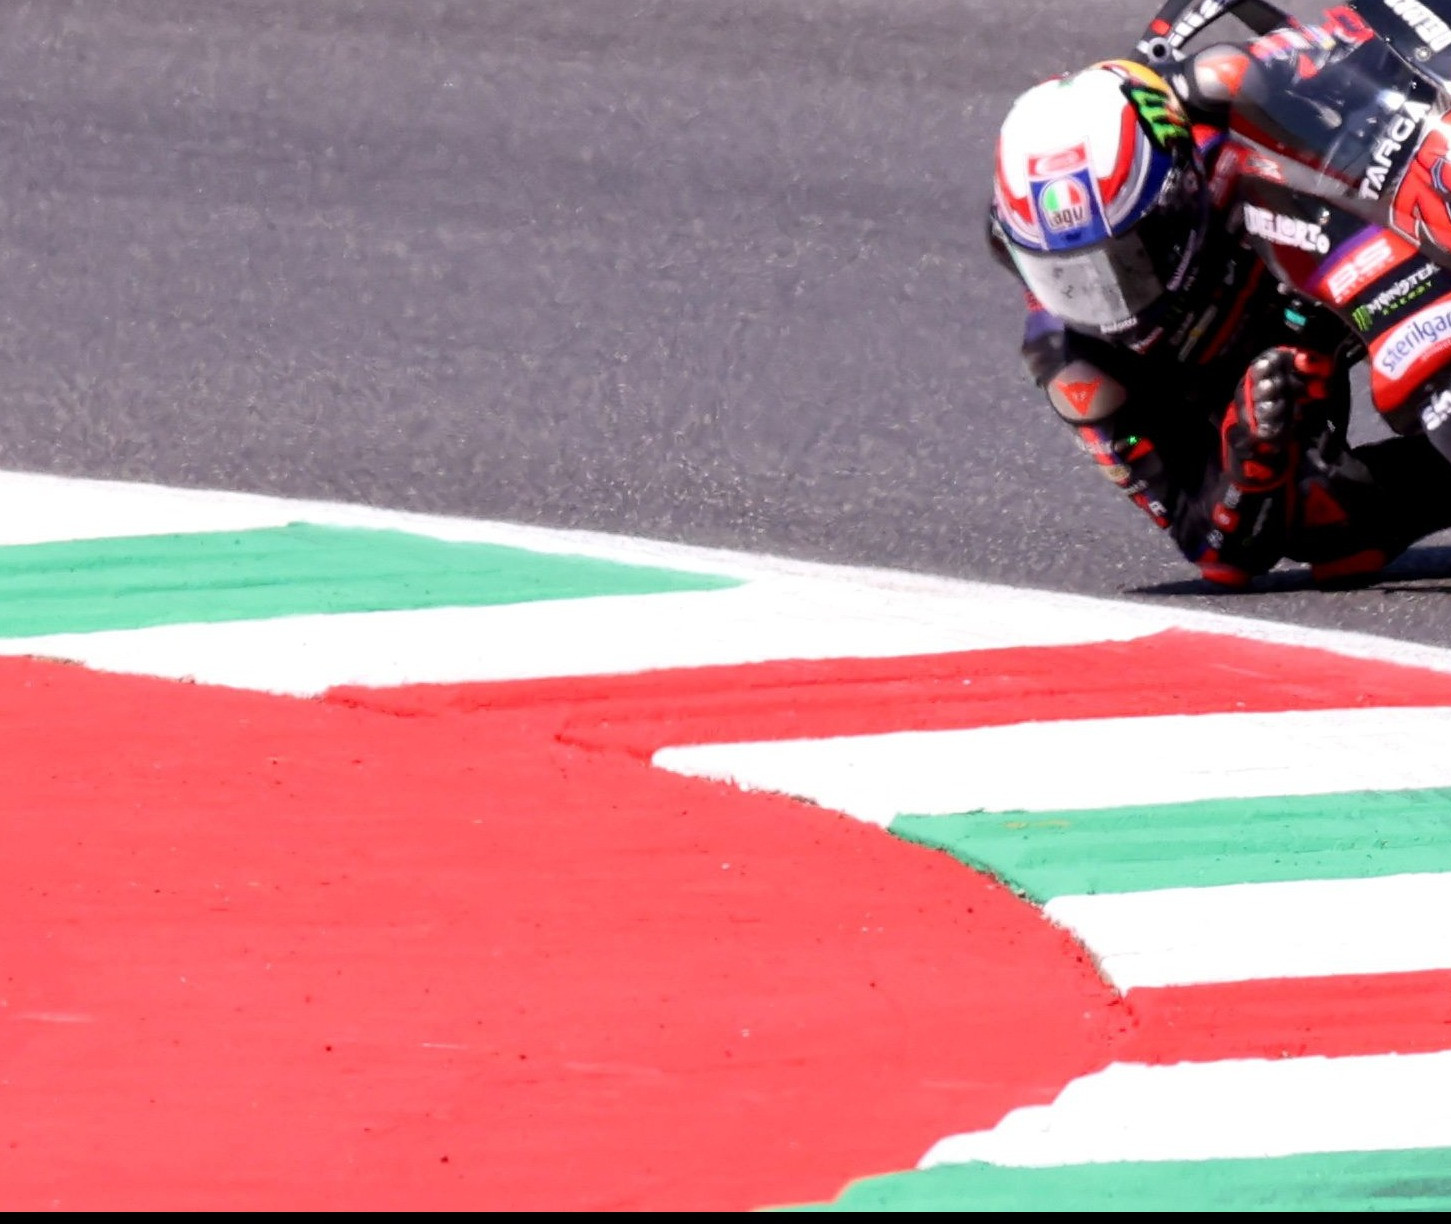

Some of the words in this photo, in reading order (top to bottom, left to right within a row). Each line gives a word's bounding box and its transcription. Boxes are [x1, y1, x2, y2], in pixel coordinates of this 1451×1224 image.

[1358, 100, 1431, 200] TARGA
[1051, 207, 1084, 225] agv
[1366, 262, 1441, 314] MONSTER
